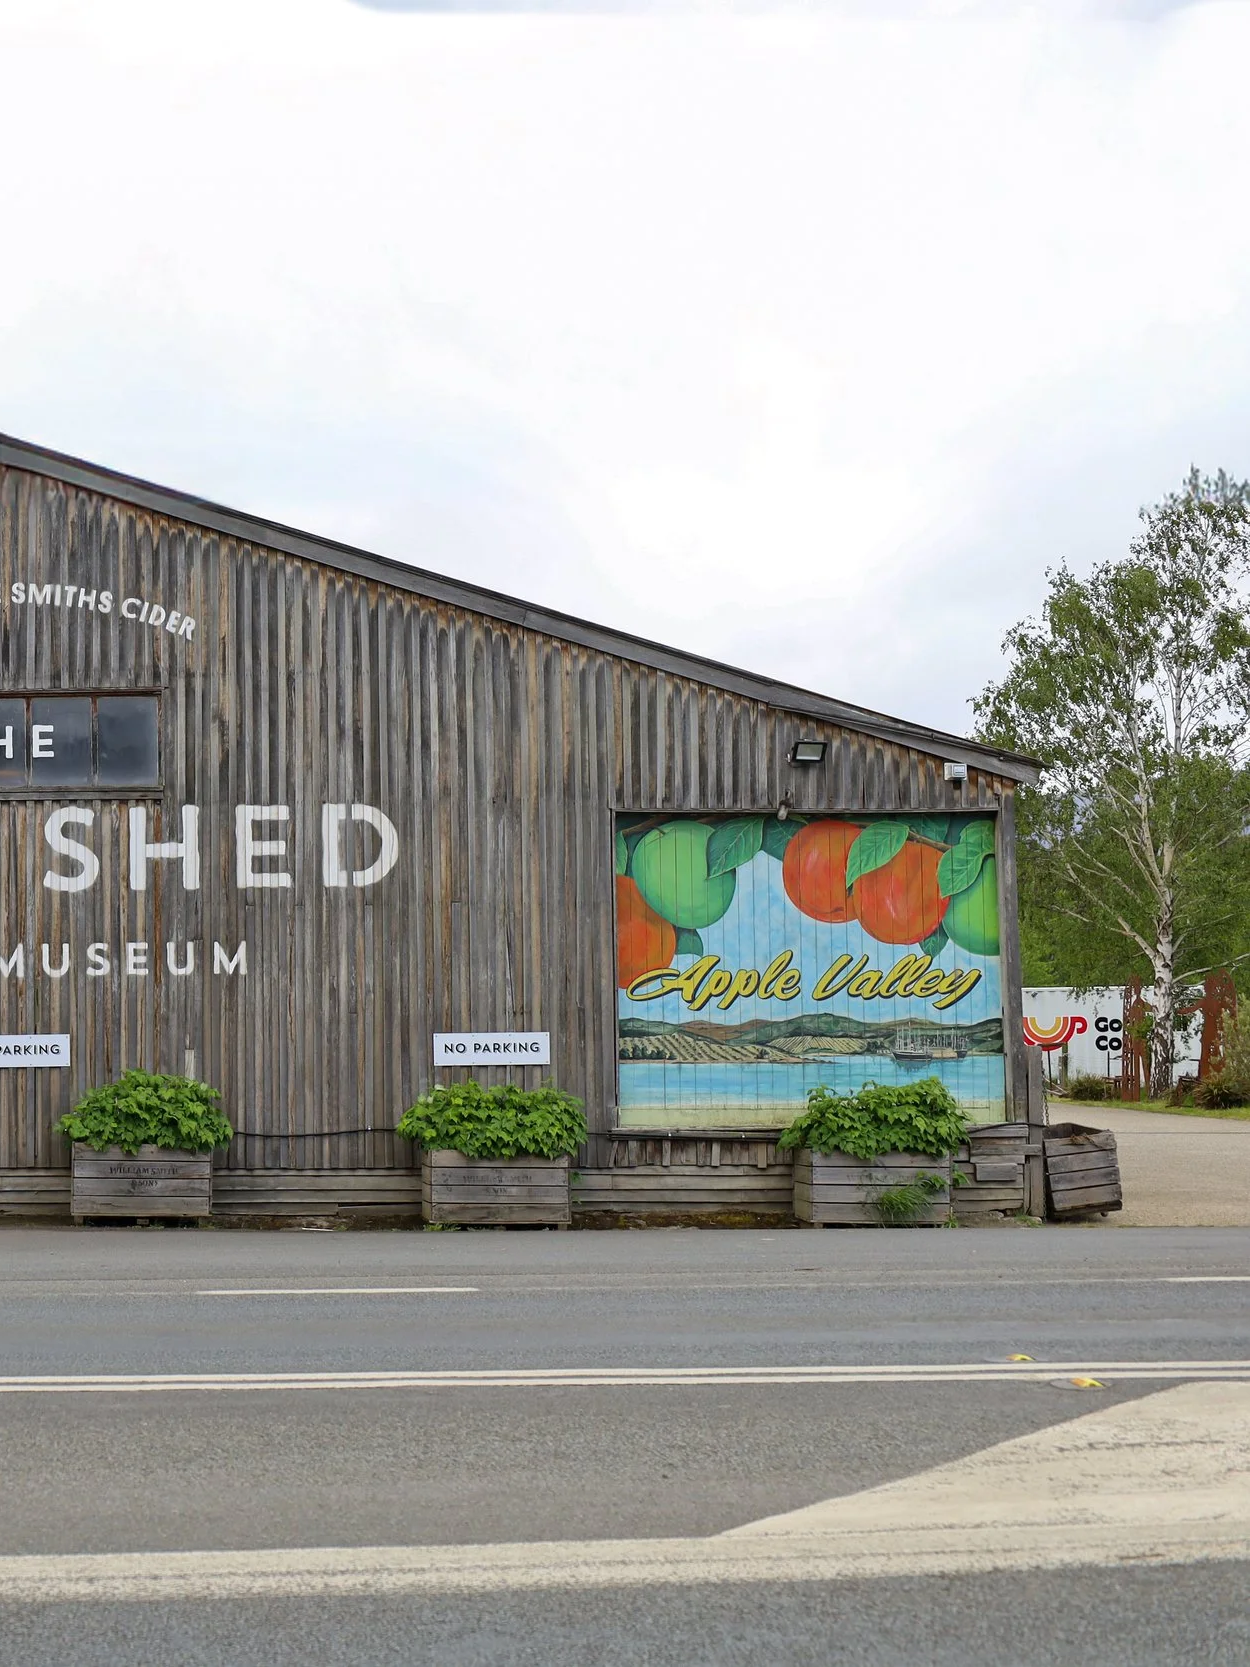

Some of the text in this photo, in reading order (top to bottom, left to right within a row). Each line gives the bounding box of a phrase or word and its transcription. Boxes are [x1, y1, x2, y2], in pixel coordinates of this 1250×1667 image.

[11, 582, 113, 614] SMITHS
[121, 597, 196, 641] CIDER
[42, 803, 399, 893] SHED
[626, 949, 983, 1012] Apple Valley
[444, 1042, 541, 1054] NO PARKING
